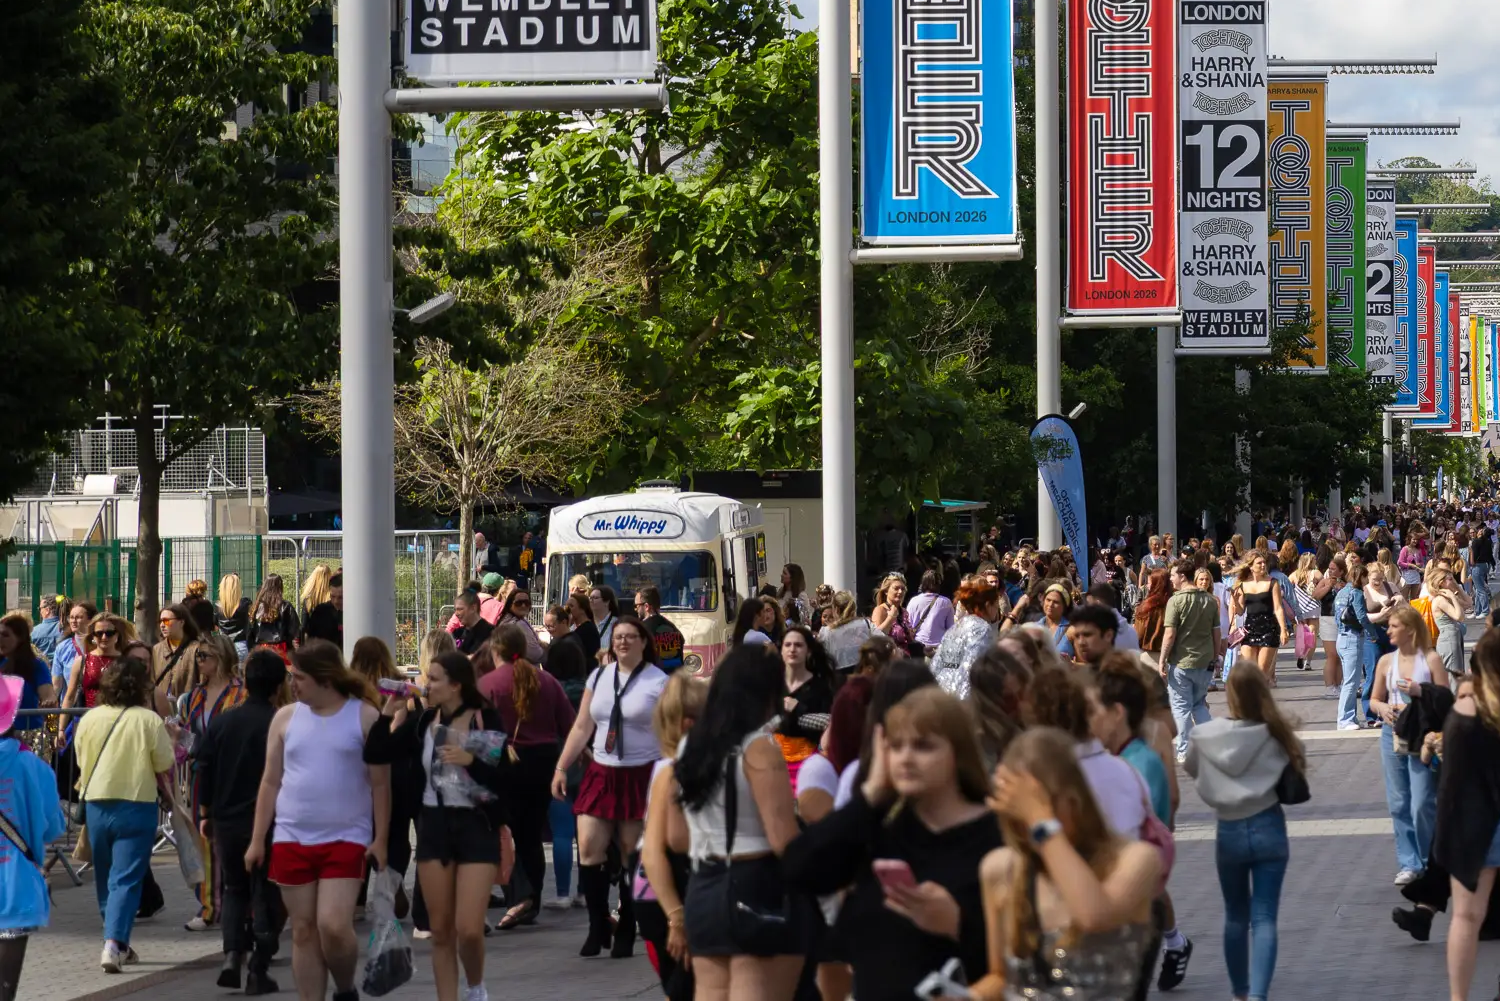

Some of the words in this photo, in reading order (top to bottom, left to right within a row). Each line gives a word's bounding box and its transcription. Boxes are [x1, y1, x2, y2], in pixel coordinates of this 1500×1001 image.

[1184, 5, 1262, 20] LONDON
[420, 15, 641, 47] STADIUM
[1192, 29, 1253, 54] TOGETHER
[1192, 56, 1255, 71] HARRY
[1193, 91, 1256, 115] TOGETHER
[1186, 124, 1260, 188] 12
[1187, 192, 1261, 208] NIGHTS
[1368, 190, 1392, 200] DON
[888, 211, 950, 224] LONDON
[954, 210, 987, 223] 2026
[1192, 217, 1254, 242] TOGETHER
[1367, 222, 1388, 230] RRY
[1367, 232, 1394, 240] ANIA
[1193, 245, 1256, 260] HARRY
[1366, 263, 1391, 301] 2
[1086, 290, 1130, 300] LONDON
[1134, 290, 1157, 299] 2026
[1193, 279, 1257, 304] TOGETHER
[1368, 304, 1392, 314] HTS
[1186, 312, 1263, 322] WEMBLEY
[1186, 324, 1263, 335] STADIUM
[1367, 336, 1388, 345] RRY
[1368, 346, 1394, 355] ANIA
[1061, 490, 1080, 536] OFFICIAL
[594, 520, 612, 531] Mr.
[614, 515, 667, 534] Whippy
